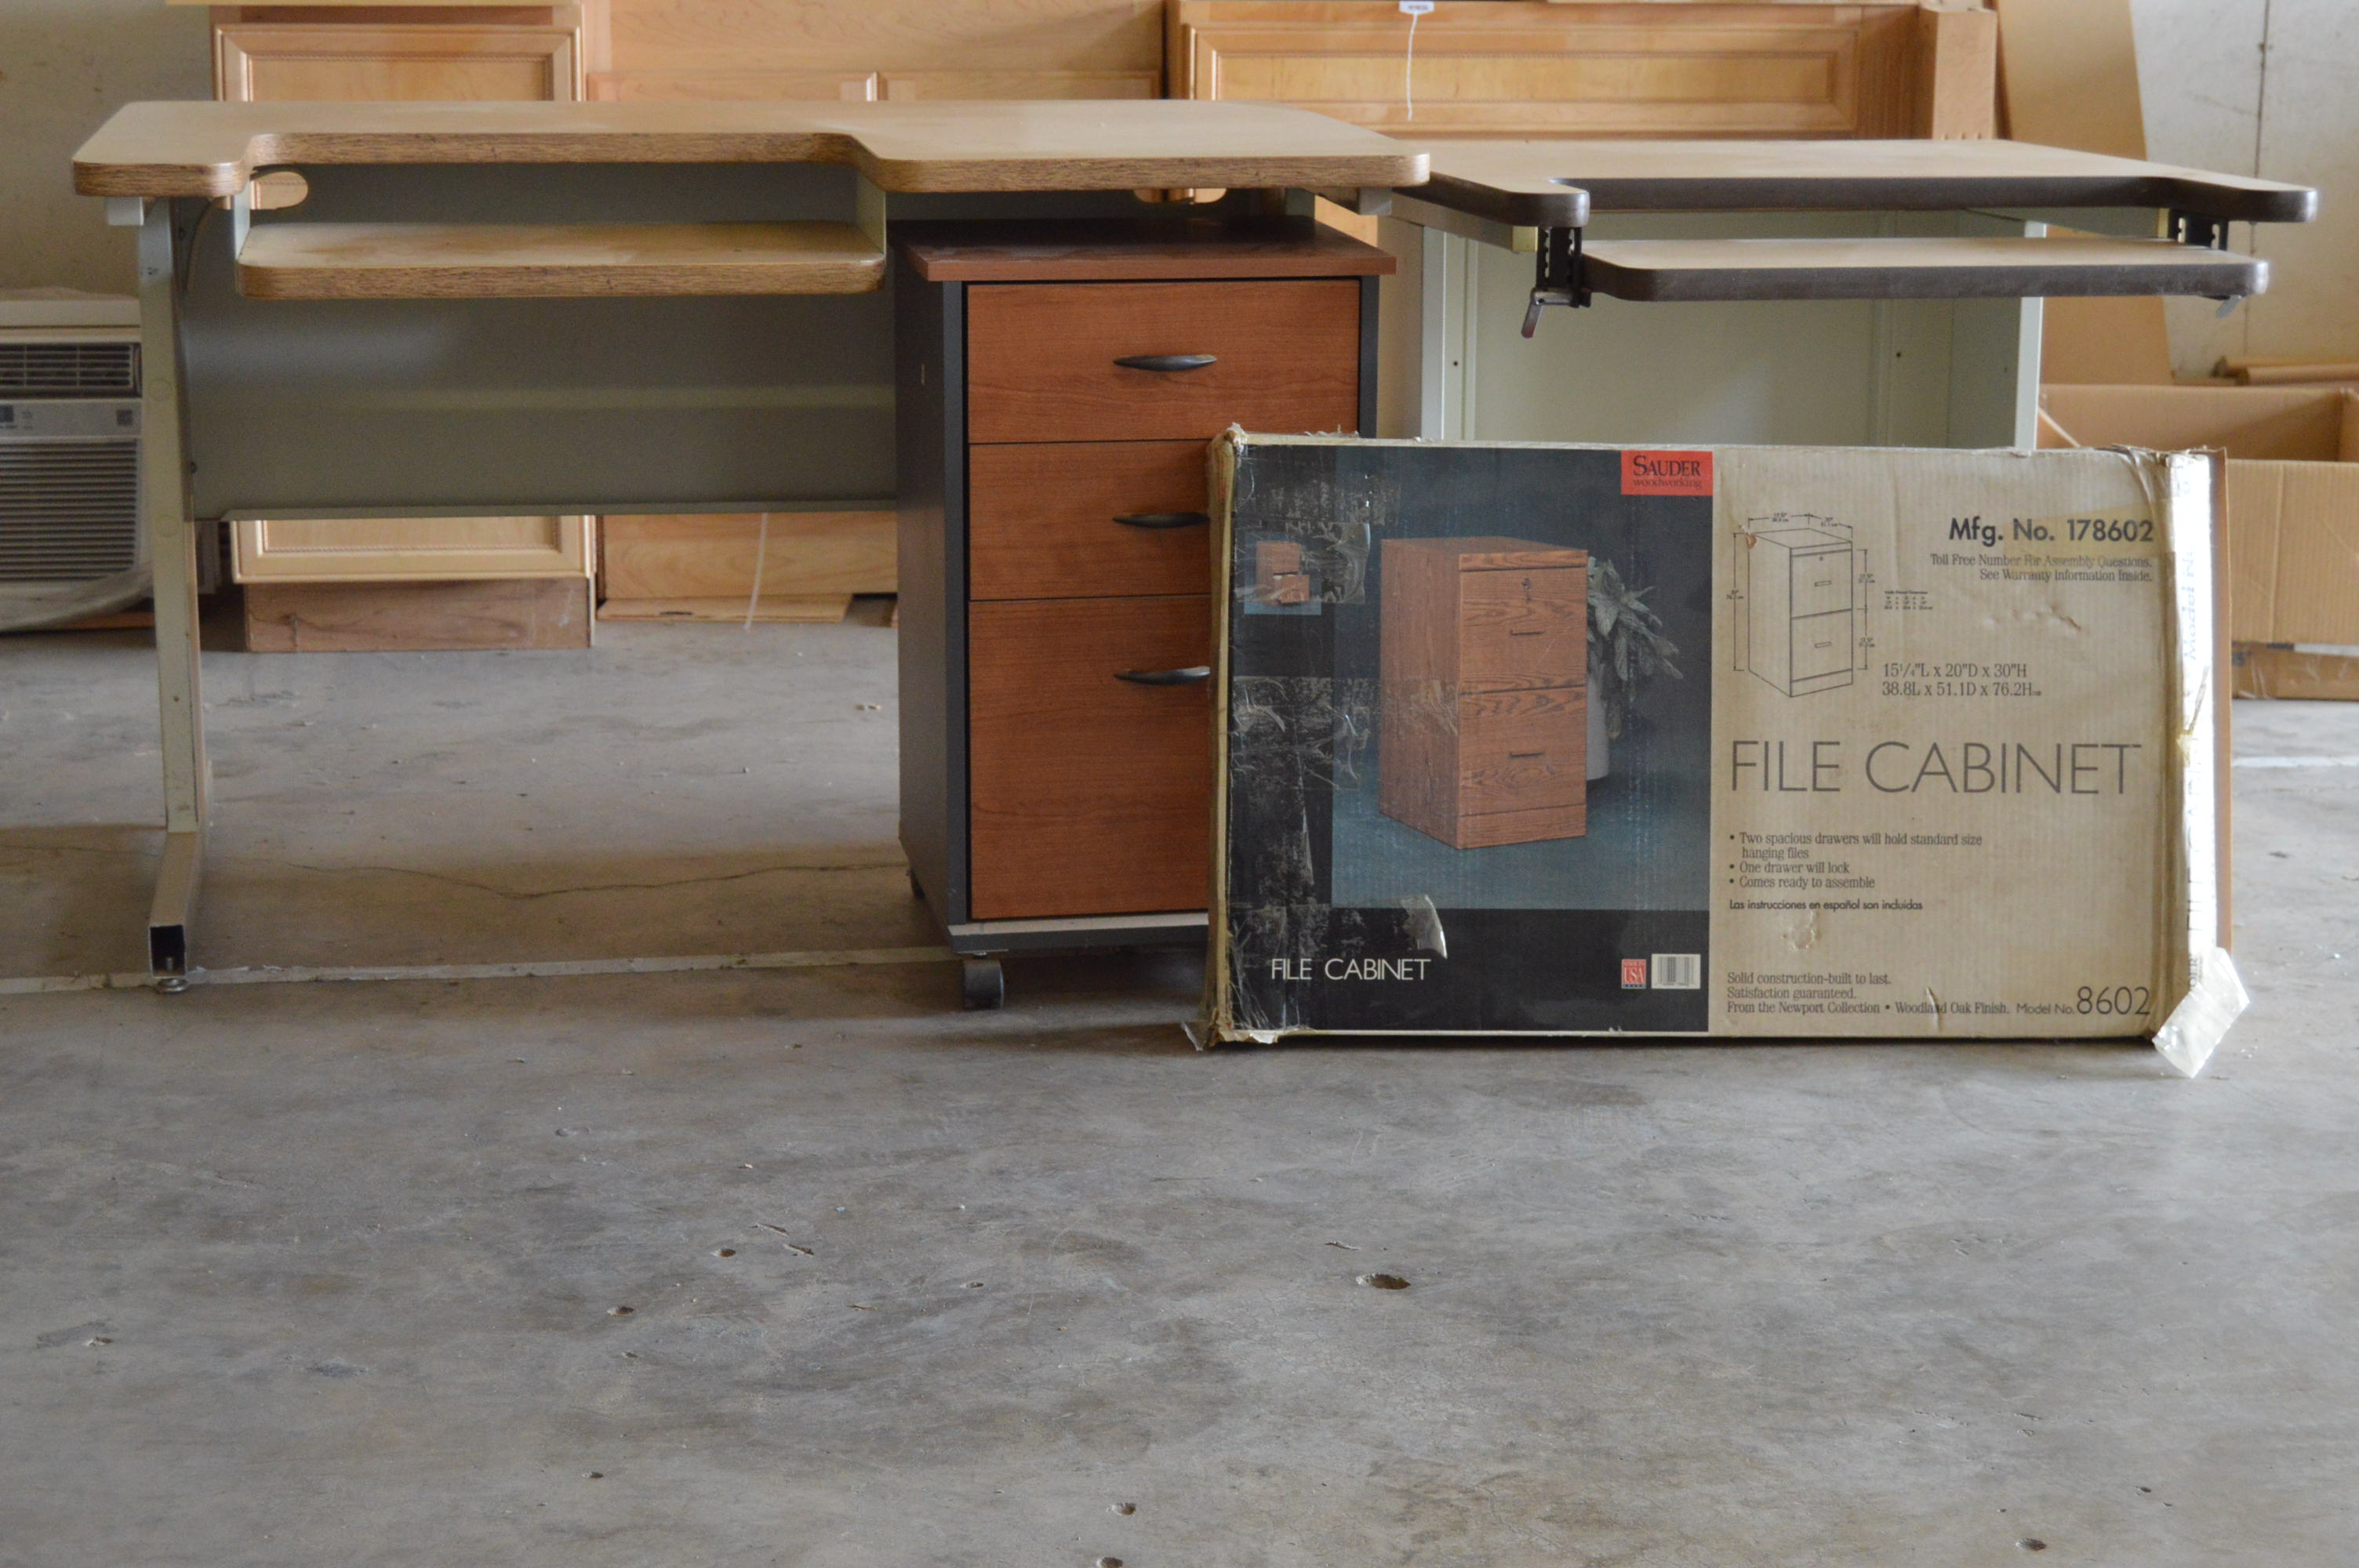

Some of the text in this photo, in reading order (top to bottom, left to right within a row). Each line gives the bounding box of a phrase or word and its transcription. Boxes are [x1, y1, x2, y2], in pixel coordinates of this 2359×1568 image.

[1633, 455, 1701, 477] SAUDER
[1948, 517, 2154, 547] Mfg. No. 178602
[1930, 554, 2152, 568] Toll Free Number For Assembly Questions.
[1980, 569, 2153, 583] See Warranty Information Inside.
[1882, 681, 1921, 696] 38.8L
[1937, 682, 1976, 696] 51.1D
[1732, 740, 1840, 792] FILE
[1865, 741, 2142, 794] CABINET
[1739, 833, 1983, 846] Two spacious drawers will hold standard size
[1742, 847, 1809, 860] hanging files
[1739, 862, 1850, 873] One drawer will lock
[1739, 876, 1875, 890] Comes ready to assemble
[1729, 899, 1744, 909] Las
[1747, 899, 1806, 909] instrucciones
[1823, 898, 1859, 912] español
[1271, 958, 1431, 980] FILE CABINET
[1623, 967, 1645, 983] USA
[1727, 972, 1892, 985] Solid construction-built to last.
[1727, 987, 1857, 1000] Satisfaction guaranteed.
[1727, 1001, 1754, 1013] From
[1758, 1001, 1775, 1013] the
[1778, 1002, 1824, 1015] Newport
[1827, 1001, 1881, 1014] Collection
[1950, 1002, 1972, 1014] Oak
[1975, 1002, 2009, 1014] Finish.
[2016, 1004, 2051, 1014] Model
[2055, 1004, 2075, 1015] No.
[2077, 986, 2150, 1015] 8602
